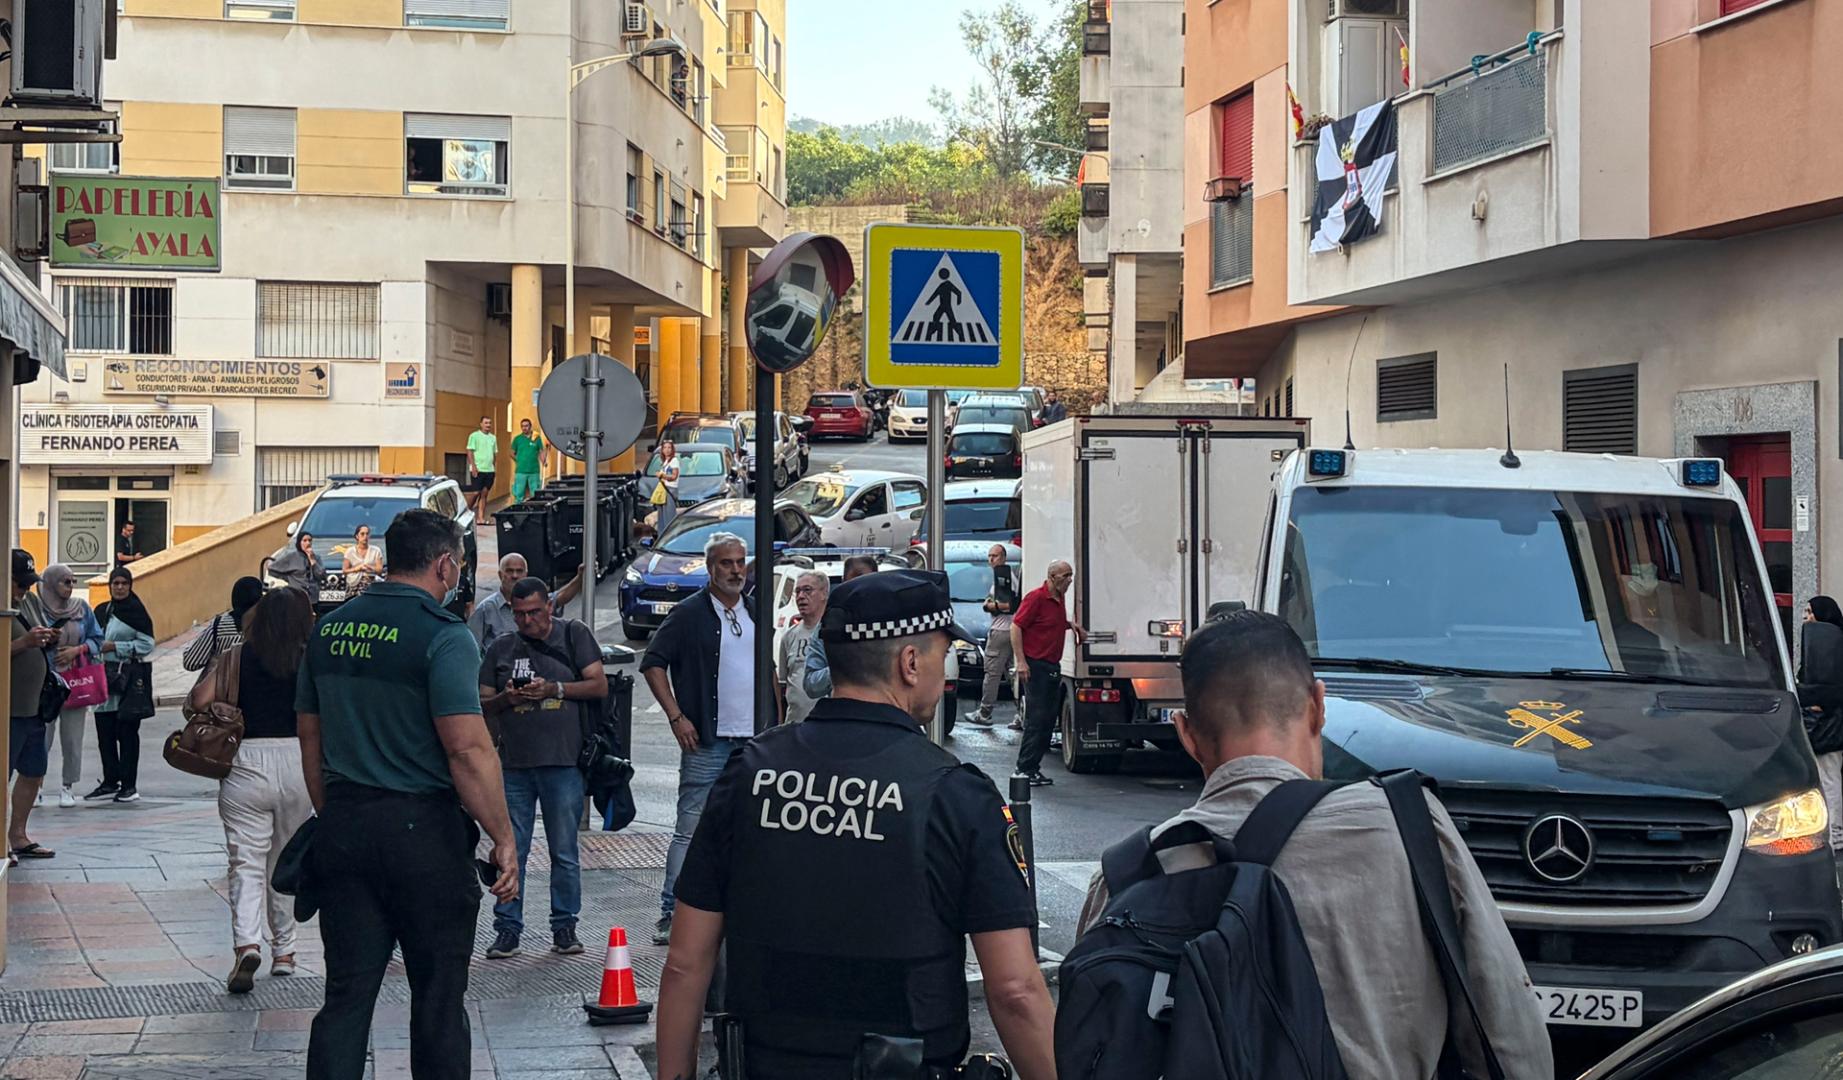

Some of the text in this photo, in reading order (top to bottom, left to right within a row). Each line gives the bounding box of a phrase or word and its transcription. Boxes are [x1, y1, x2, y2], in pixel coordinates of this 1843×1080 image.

[56, 184, 214, 218] PAPELERÍA
[129, 231, 214, 257] AYALA
[133, 359, 301, 376] RECONOCIMIENTOS
[135, 374, 300, 385] CONDUCTORES ARMAS ANIMALES PELIGROSOS
[136, 384, 297, 395] SEGURIDAD PRIVADA EMBARCACIONES RECREO
[22, 411, 199, 429] CLÍNICA FISIOTERAPIA OSTEOPATIA
[41, 436, 179, 450] FERNANDO PEREA
[320, 622, 399, 643] GUARDIA
[330, 640, 372, 659] CIVIL
[514, 658, 530, 670] THE
[752, 768, 904, 812] POLICIA
[760, 798, 885, 841] LOCAL
